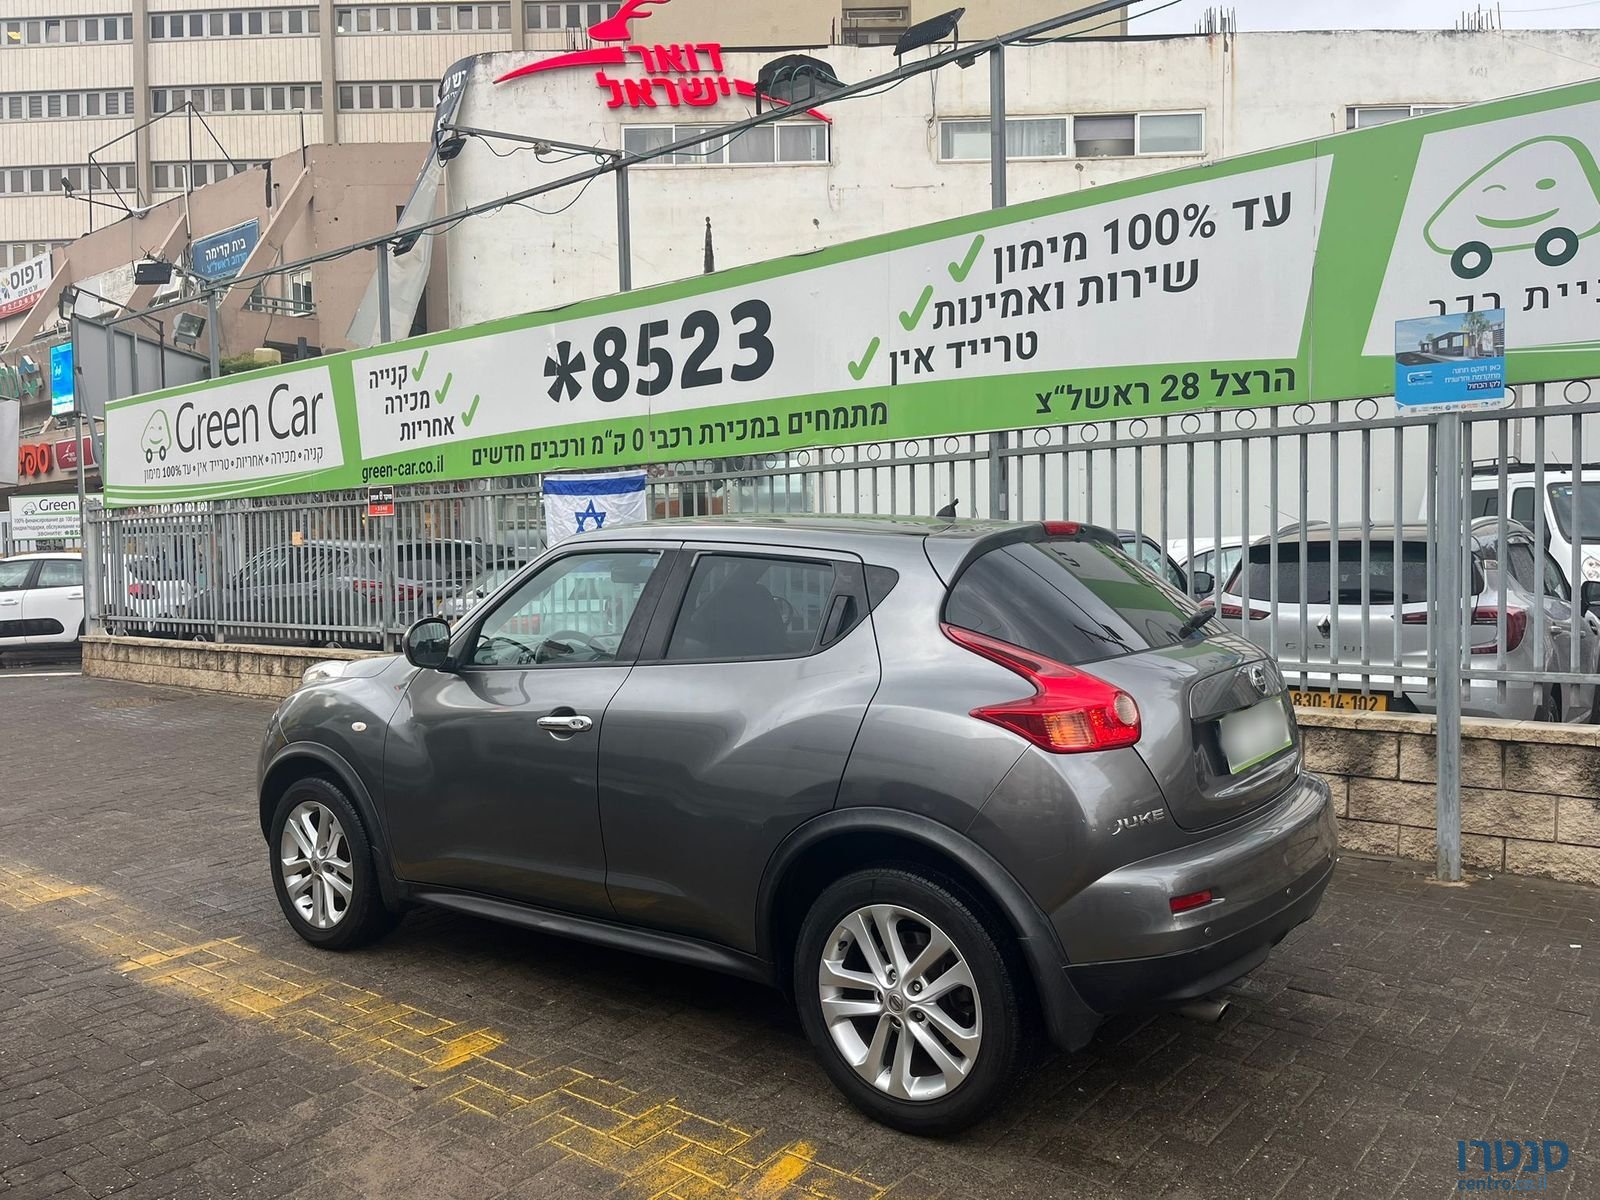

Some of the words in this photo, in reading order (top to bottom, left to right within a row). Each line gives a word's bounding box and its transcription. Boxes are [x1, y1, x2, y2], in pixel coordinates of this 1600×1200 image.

[628, 43, 724, 74] דואר
[595, 72, 731, 109] ישראל
[1232, 191, 1291, 231] עד
[1103, 203, 1216, 255] 100%
[205, 243, 230, 261] קדימה
[231, 238, 247, 252] בית
[993, 231, 1087, 284] מימון
[10, 260, 43, 290] דפוס
[1077, 258, 1199, 307] שירות
[933, 281, 1064, 330] ואמינות
[1523, 279, 1600, 311] יית
[946, 330, 1038, 369] טרייד
[369, 365, 408, 390] קנייה
[889, 345, 935, 385] אין
[1160, 372, 1199, 402] 28
[1210, 367, 1295, 397] הרצל
[385, 390, 430, 415] מכירה
[1036, 381, 1150, 414] ראשל"צ
[175, 401, 259, 453] Green
[268, 383, 324, 440] Car
[400, 416, 455, 441] אחריות
[699, 416, 780, 445] במכירת
[788, 401, 888, 435] מתמחים
[531, 437, 585, 461] ורכבים
[591, 429, 626, 455] ק"מ
[632, 427, 644, 451] 0
[649, 426, 693, 449] רכבי
[209, 459, 230, 473] טרייד
[235, 453, 264, 469] אחריות
[270, 450, 296, 465] מכירה
[303, 446, 323, 465] קניה
[472, 443, 524, 466] חדשים
[143, 468, 161, 483] מימון
[162, 465, 182, 478] 100%
[182, 463, 192, 476] עד
[197, 461, 207, 477] אין
[362, 455, 444, 483] green-car.co.il
[38, 499, 76, 511] Green
[1111, 808, 1165, 836] JUKE
